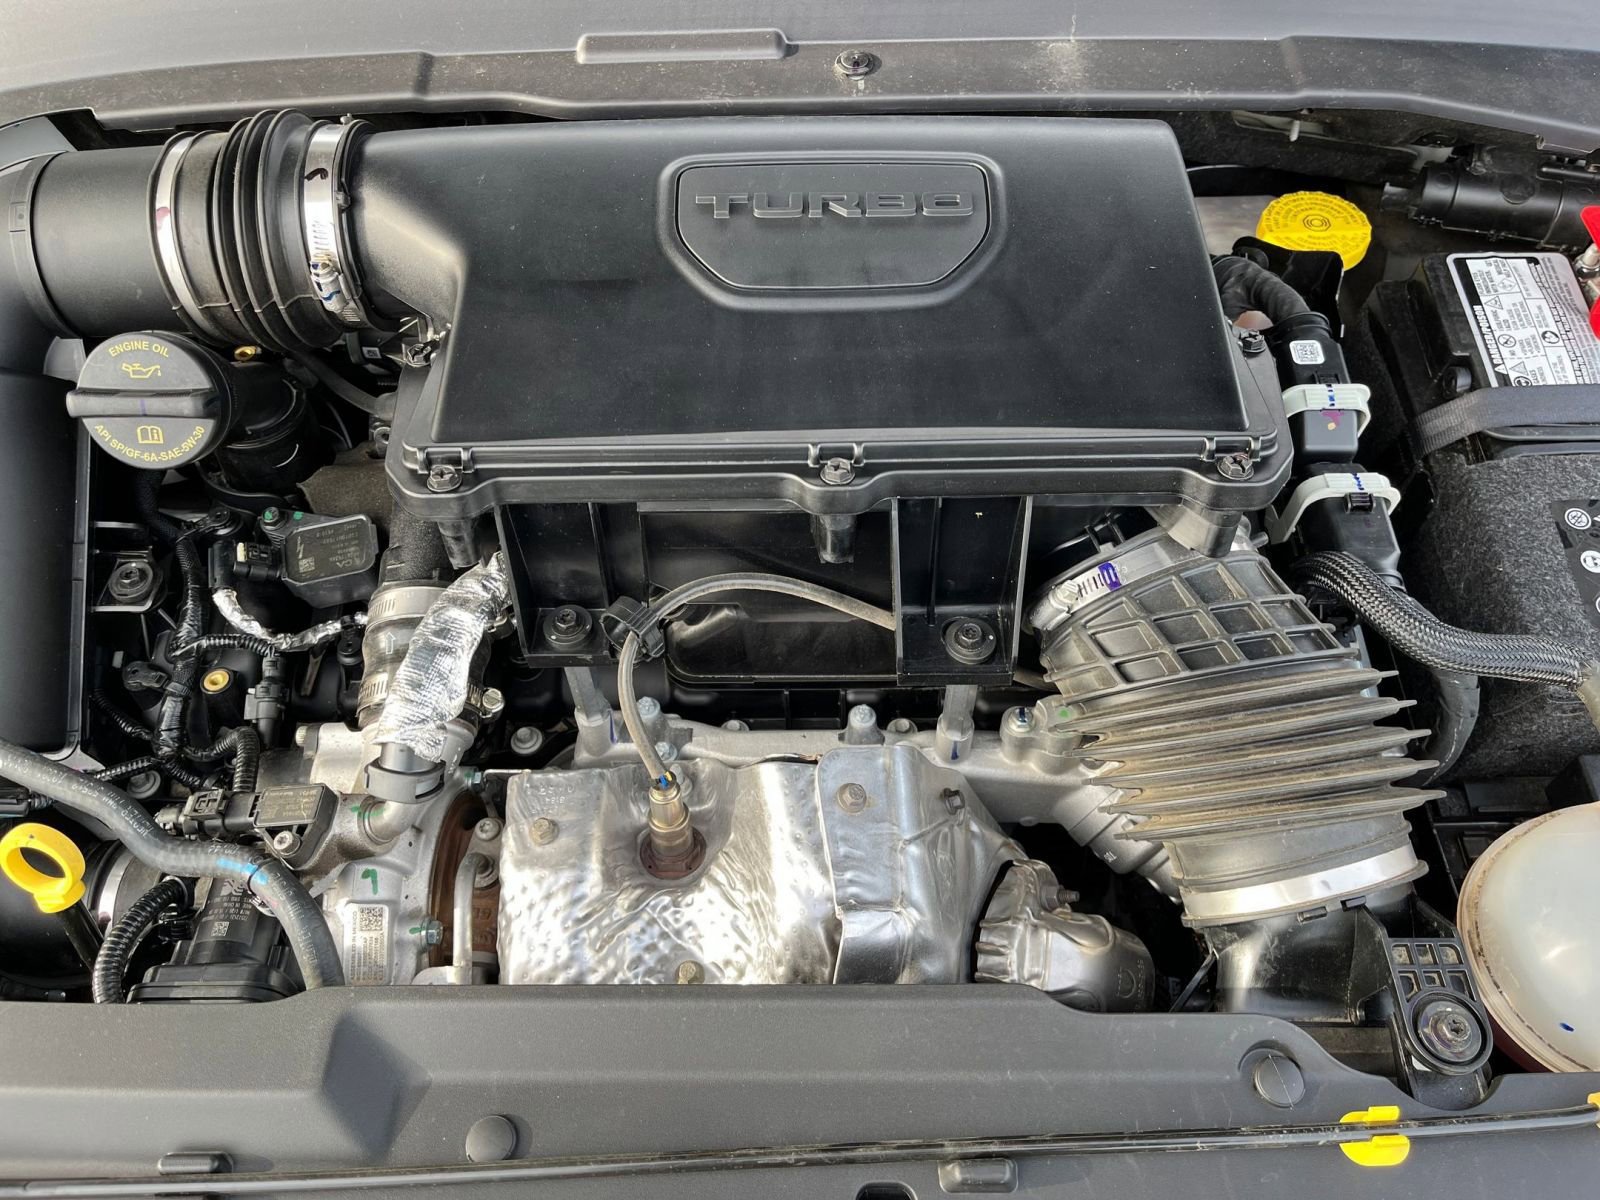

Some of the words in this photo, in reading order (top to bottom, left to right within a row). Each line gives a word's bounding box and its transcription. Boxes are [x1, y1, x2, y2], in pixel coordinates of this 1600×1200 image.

[695, 192, 974, 219] TURBO
[1472, 304, 1503, 364] DANGER/POISON
[108, 341, 149, 358] ENGINE
[152, 343, 169, 358] OIL
[94, 424, 113, 442] API
